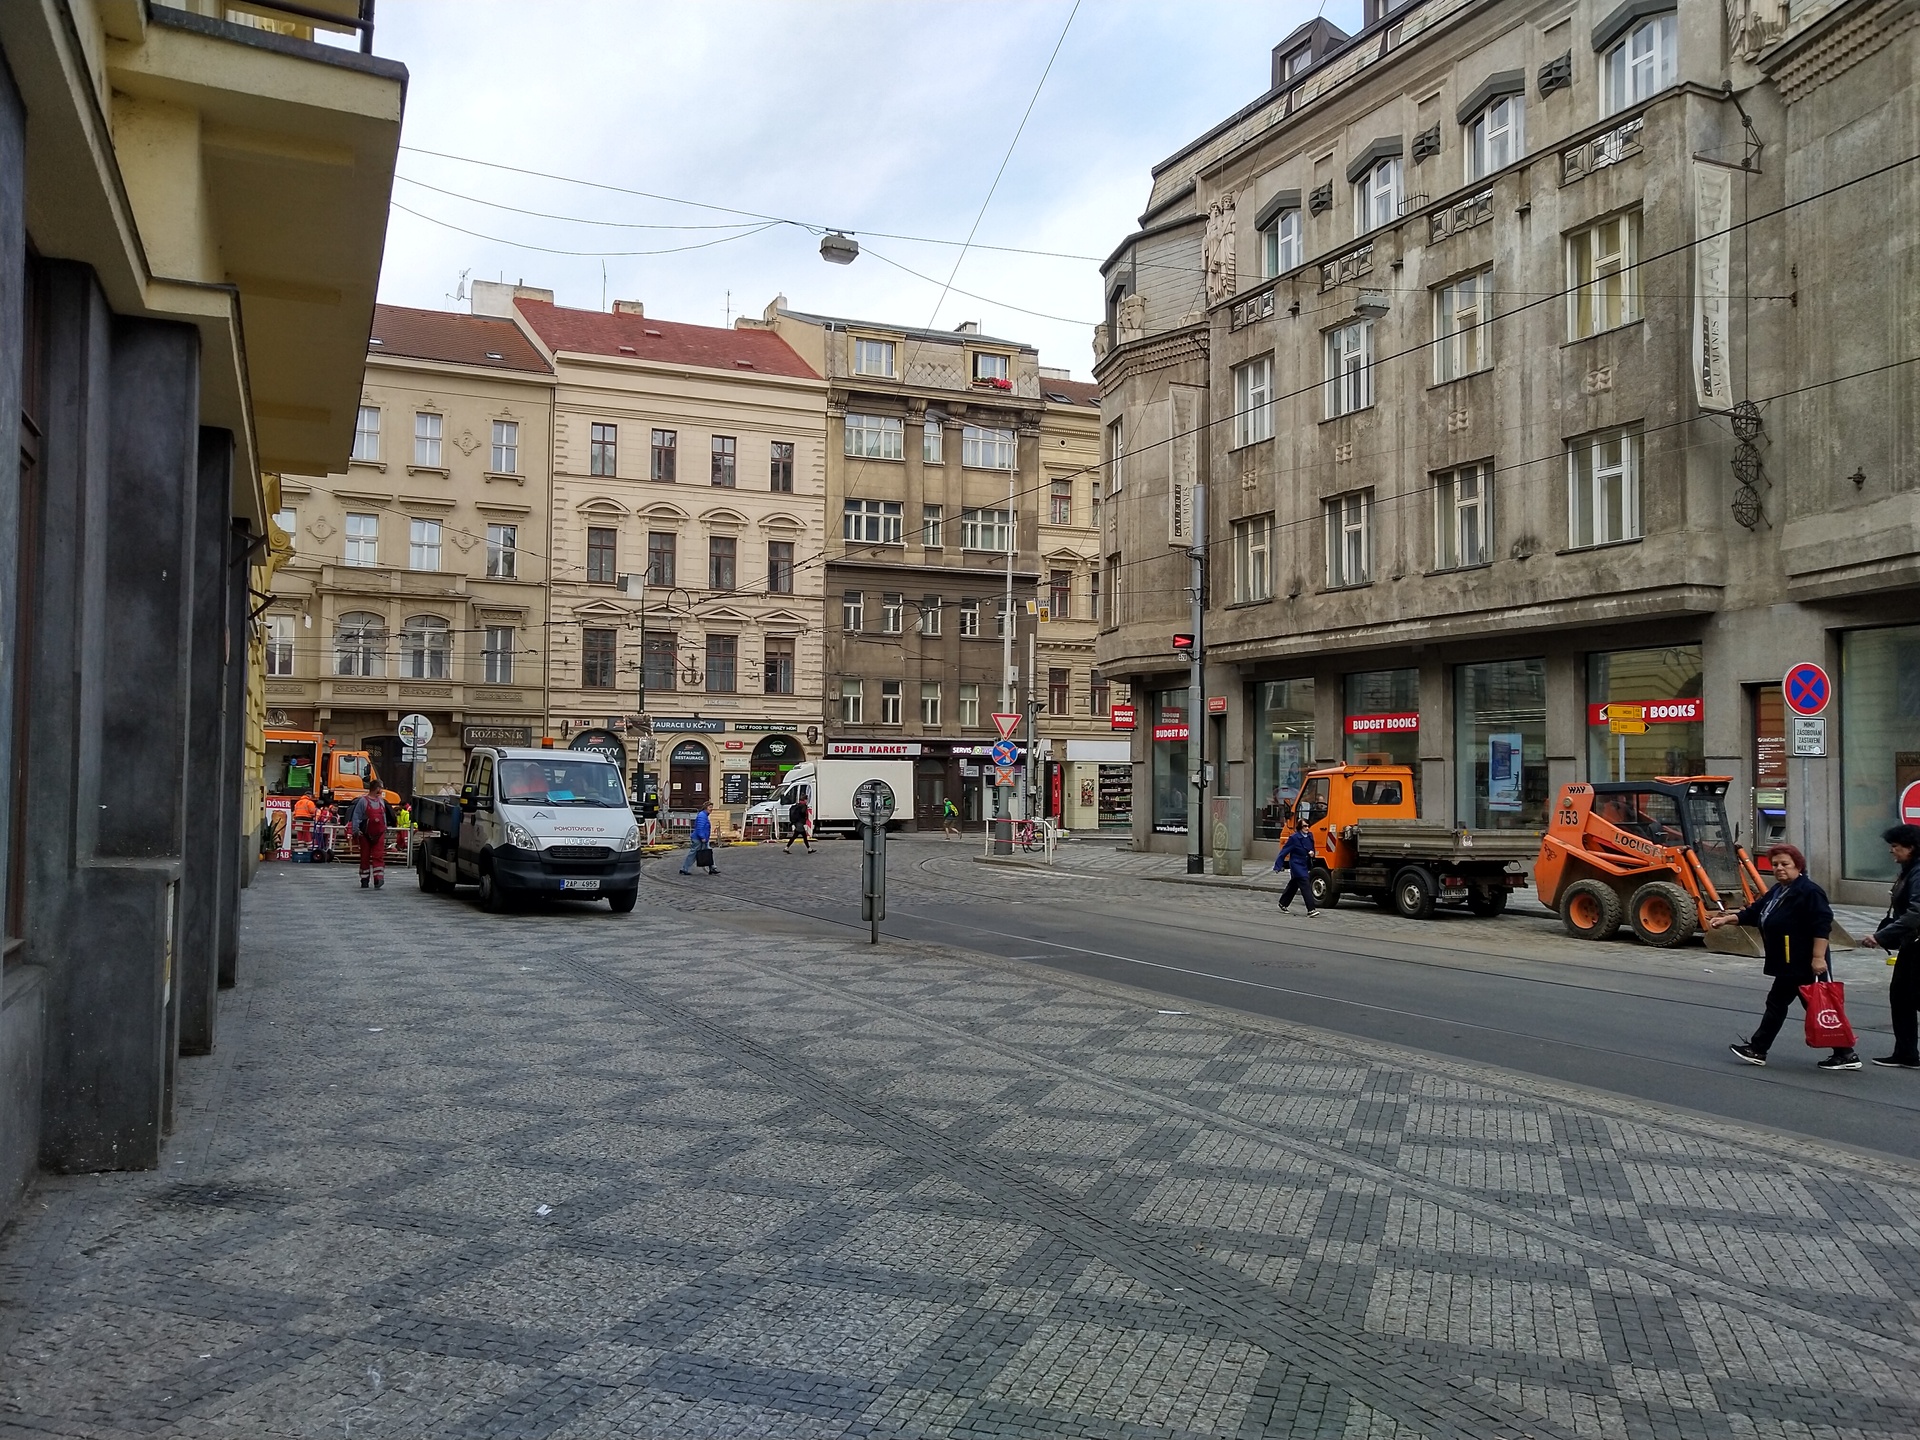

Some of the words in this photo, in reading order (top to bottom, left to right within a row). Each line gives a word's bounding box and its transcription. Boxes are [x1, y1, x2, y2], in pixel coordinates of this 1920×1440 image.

[1650, 705, 1695, 718] BOOKS
[1353, 719, 1384, 730] BUDGET
[1387, 718, 1417, 728] BOOKS
[1156, 730, 1178, 738] BUDGET
[1568, 786, 1586, 794] WAY
[266, 799, 291, 808] DÖNER
[1559, 811, 1578, 825] 753
[1615, 833, 1660, 857] LOCUST
